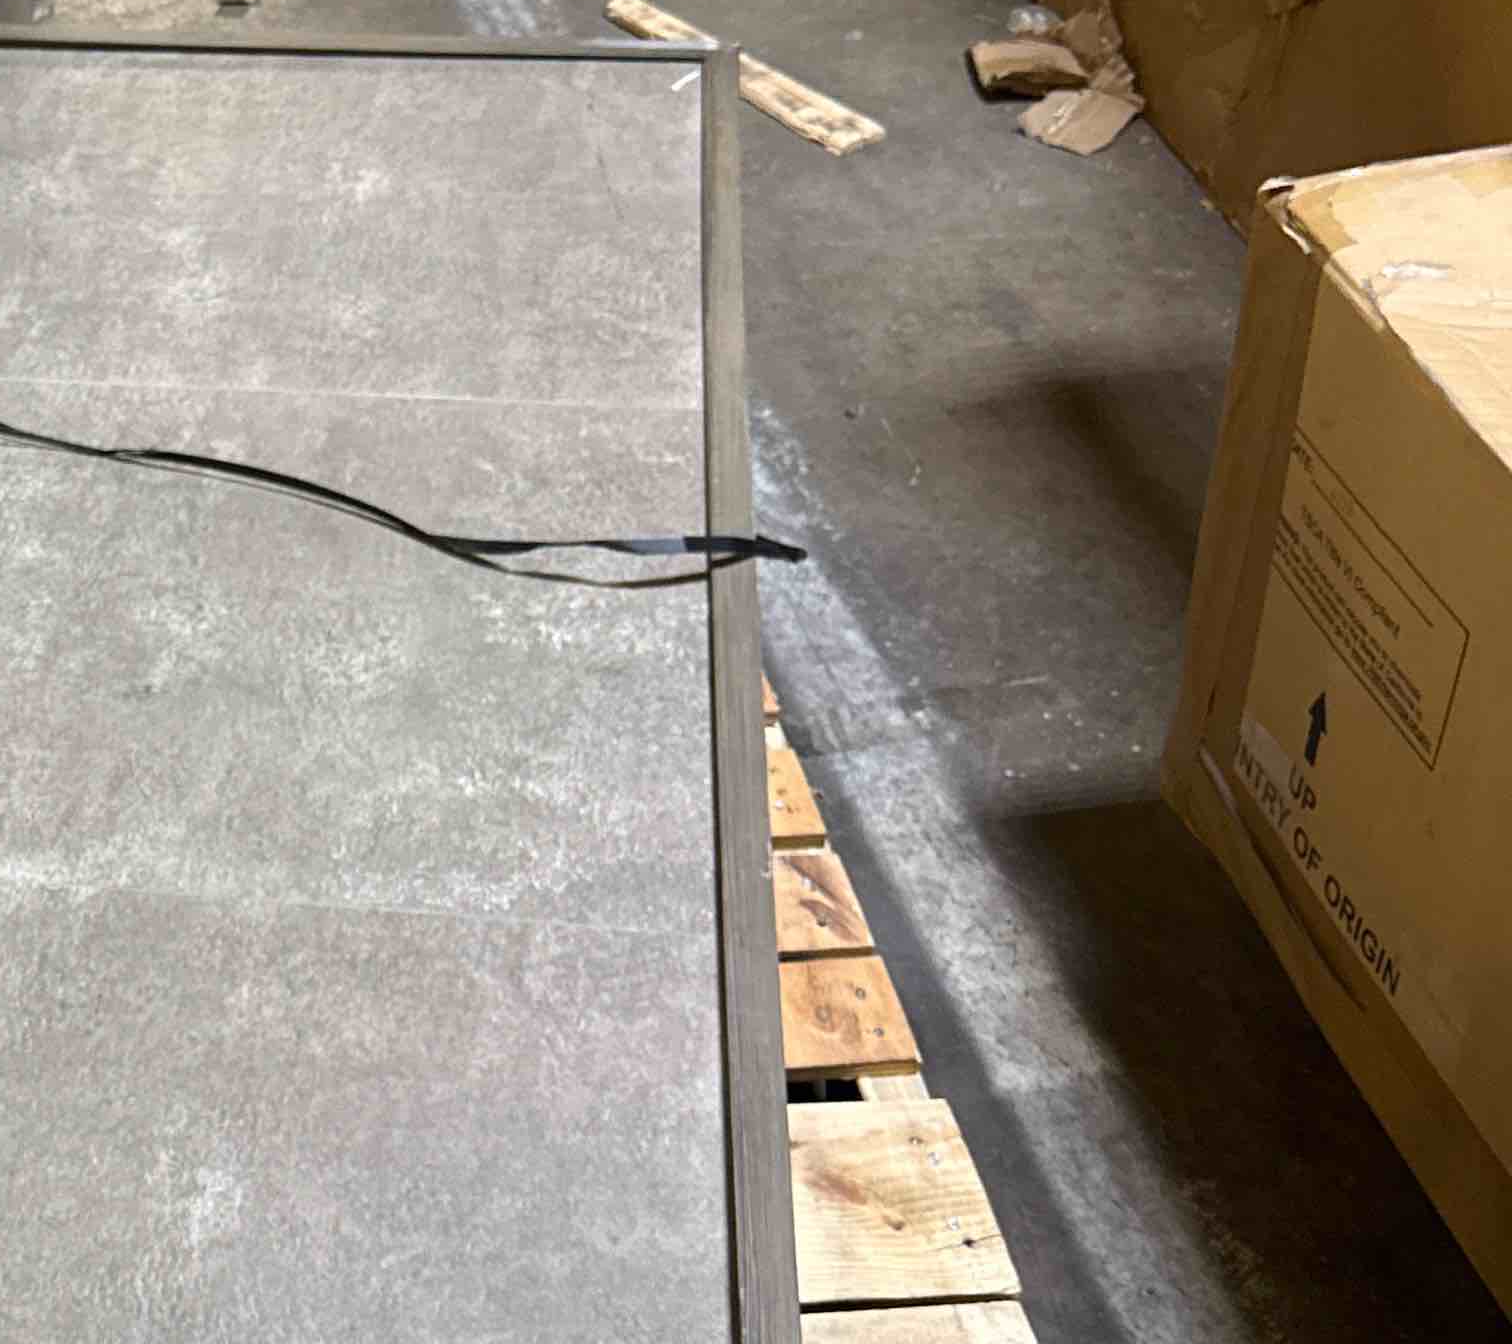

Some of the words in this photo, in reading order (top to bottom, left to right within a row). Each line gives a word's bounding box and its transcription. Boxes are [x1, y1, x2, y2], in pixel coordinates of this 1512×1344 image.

[1288, 763, 1318, 811] UP
[1234, 742, 1291, 828] NTRY
[1293, 826, 1322, 872] OF
[1324, 874, 1401, 997] ORIGIN
